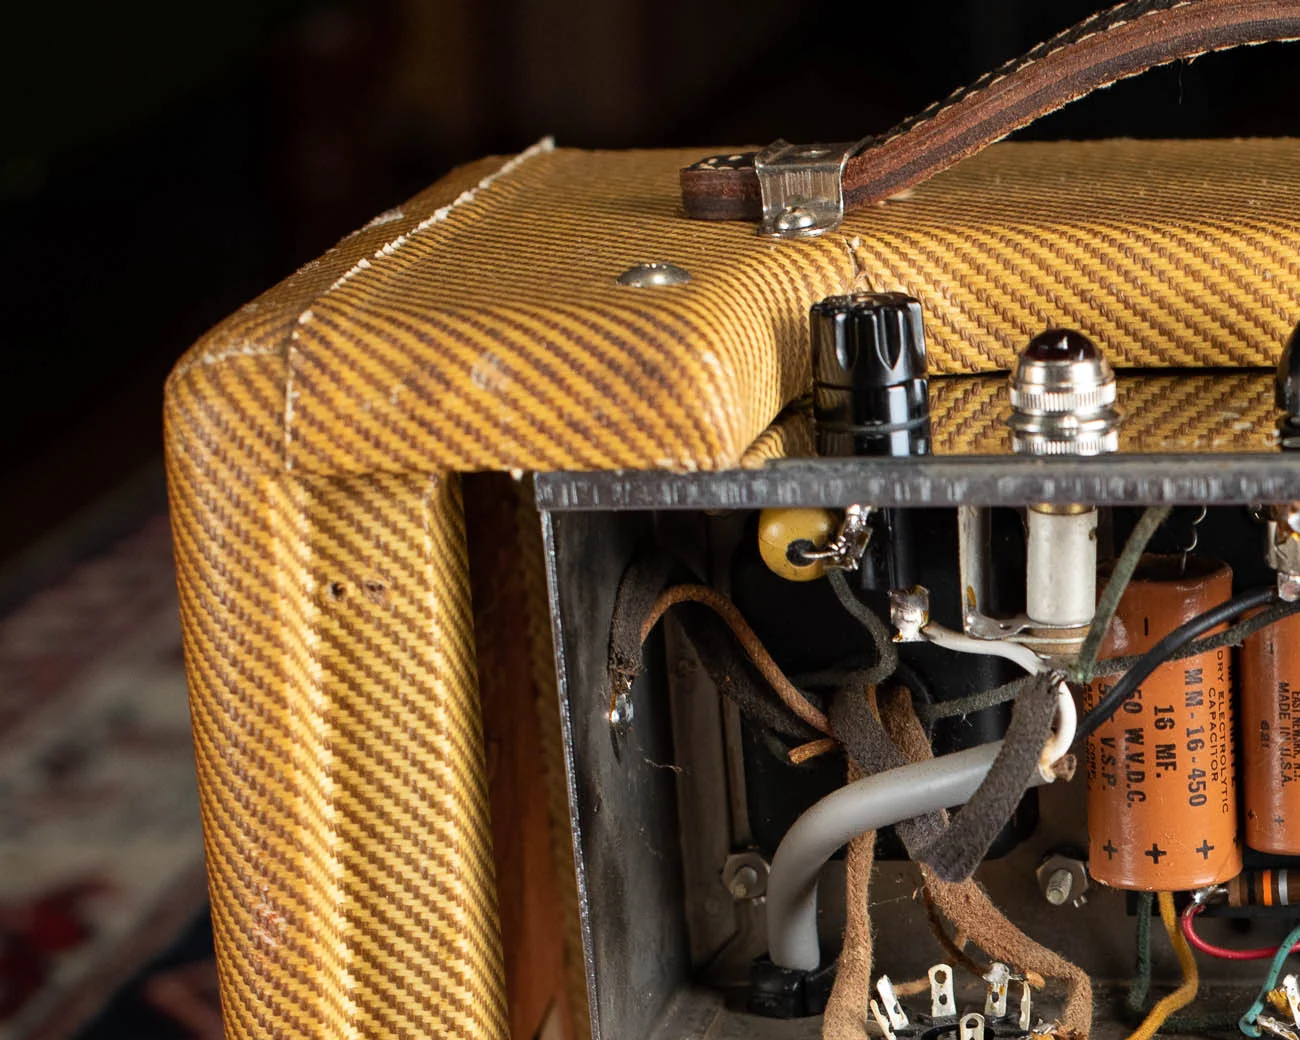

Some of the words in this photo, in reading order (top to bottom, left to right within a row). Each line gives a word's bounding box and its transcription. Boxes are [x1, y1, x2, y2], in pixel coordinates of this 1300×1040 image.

[1216, 650, 1224, 683] DRY
[1123, 684, 1143, 714] 50
[1154, 705, 1175, 730] 16
[1279, 682, 1290, 720] MADE
[1208, 688, 1219, 782] CAPACITOR
[1217, 690, 1229, 814] ELECTROLYTIC
[1280, 727, 1291, 741] IN
[1099, 737, 1116, 791] V.S.P.
[1124, 728, 1146, 808] W.V.D.C.
[1155, 744, 1177, 779] MF.
[1280, 748, 1292, 787] U.S.A.
